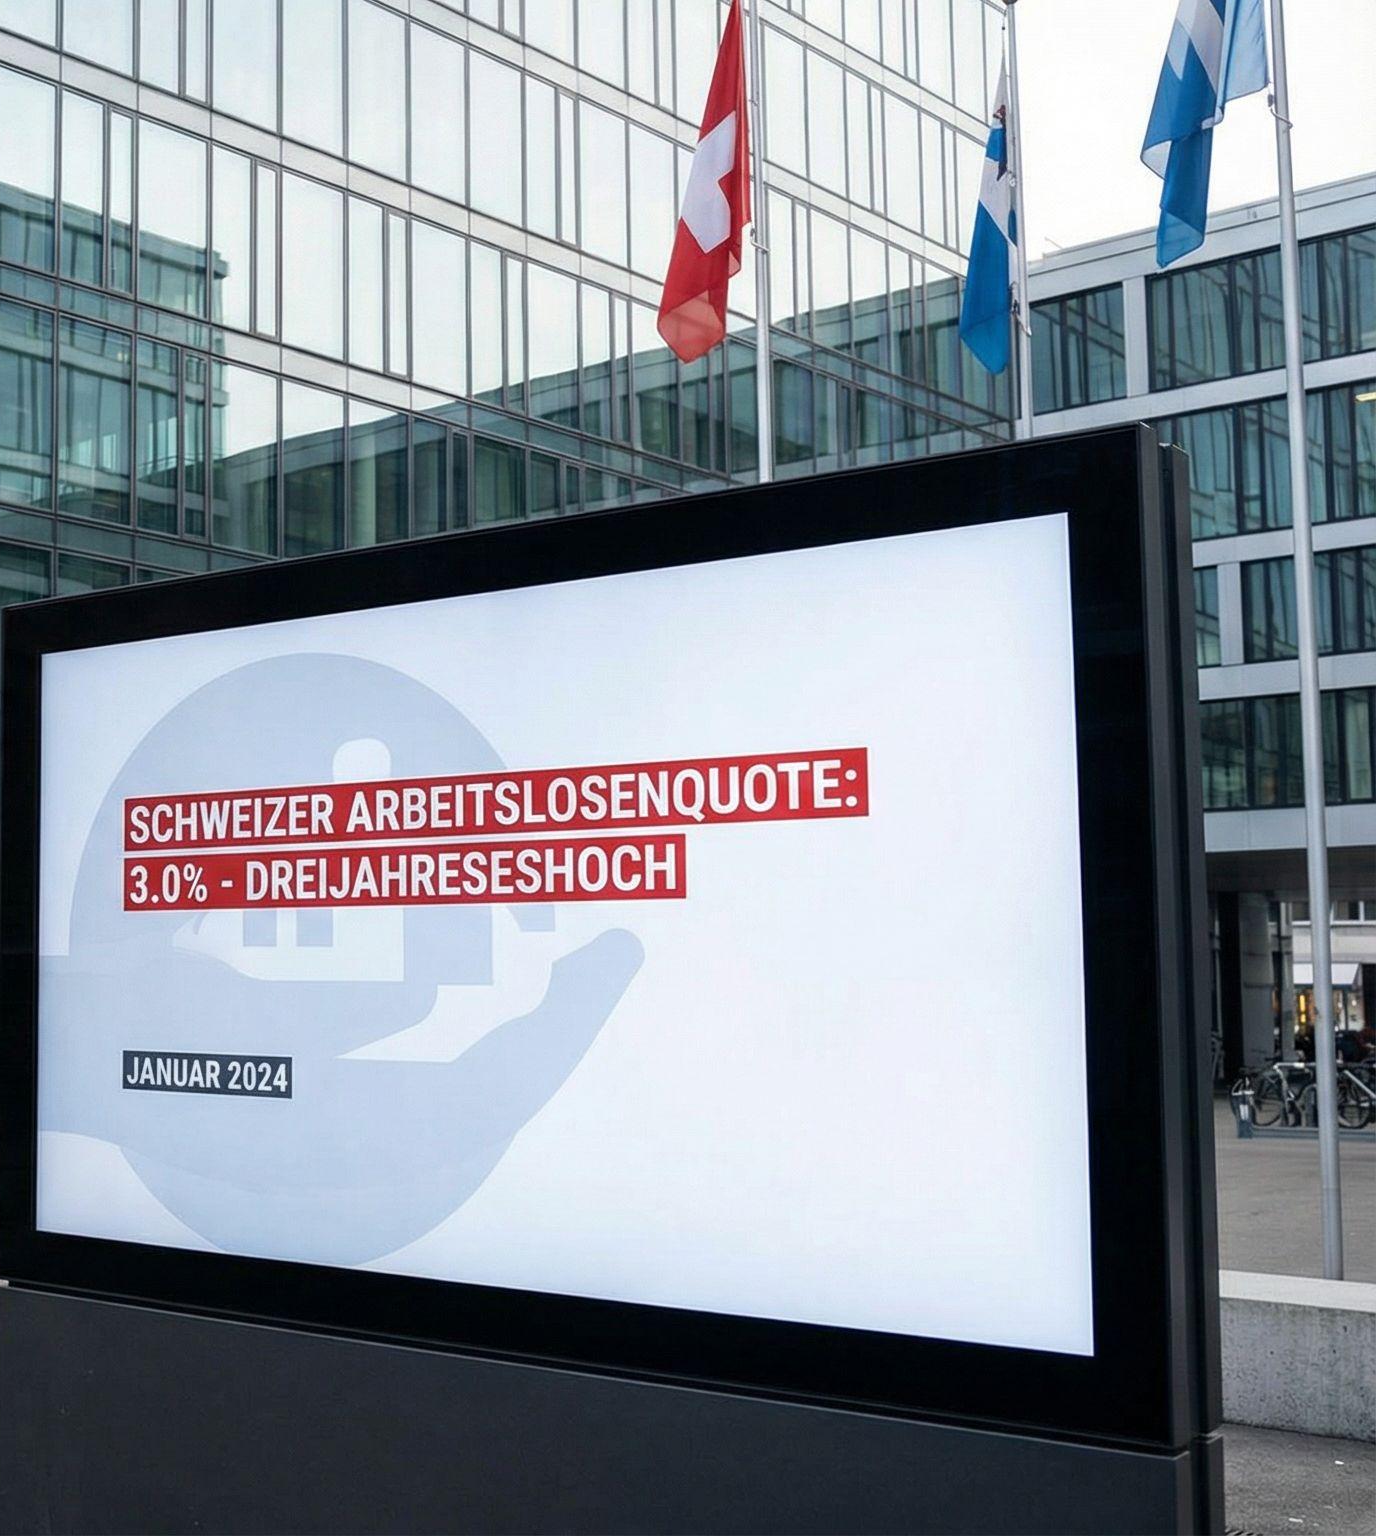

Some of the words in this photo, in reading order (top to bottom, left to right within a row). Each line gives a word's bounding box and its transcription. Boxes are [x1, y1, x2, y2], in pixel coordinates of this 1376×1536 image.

[129, 793, 335, 844] SCHWEIZER
[345, 759, 858, 833] ARBEITSLOSENQUOTE:
[129, 863, 208, 904] 3.0%
[246, 843, 677, 901] DREIJAHRESESHOCH
[126, 1057, 221, 1089] JANUAR
[227, 1061, 288, 1092] 2024
